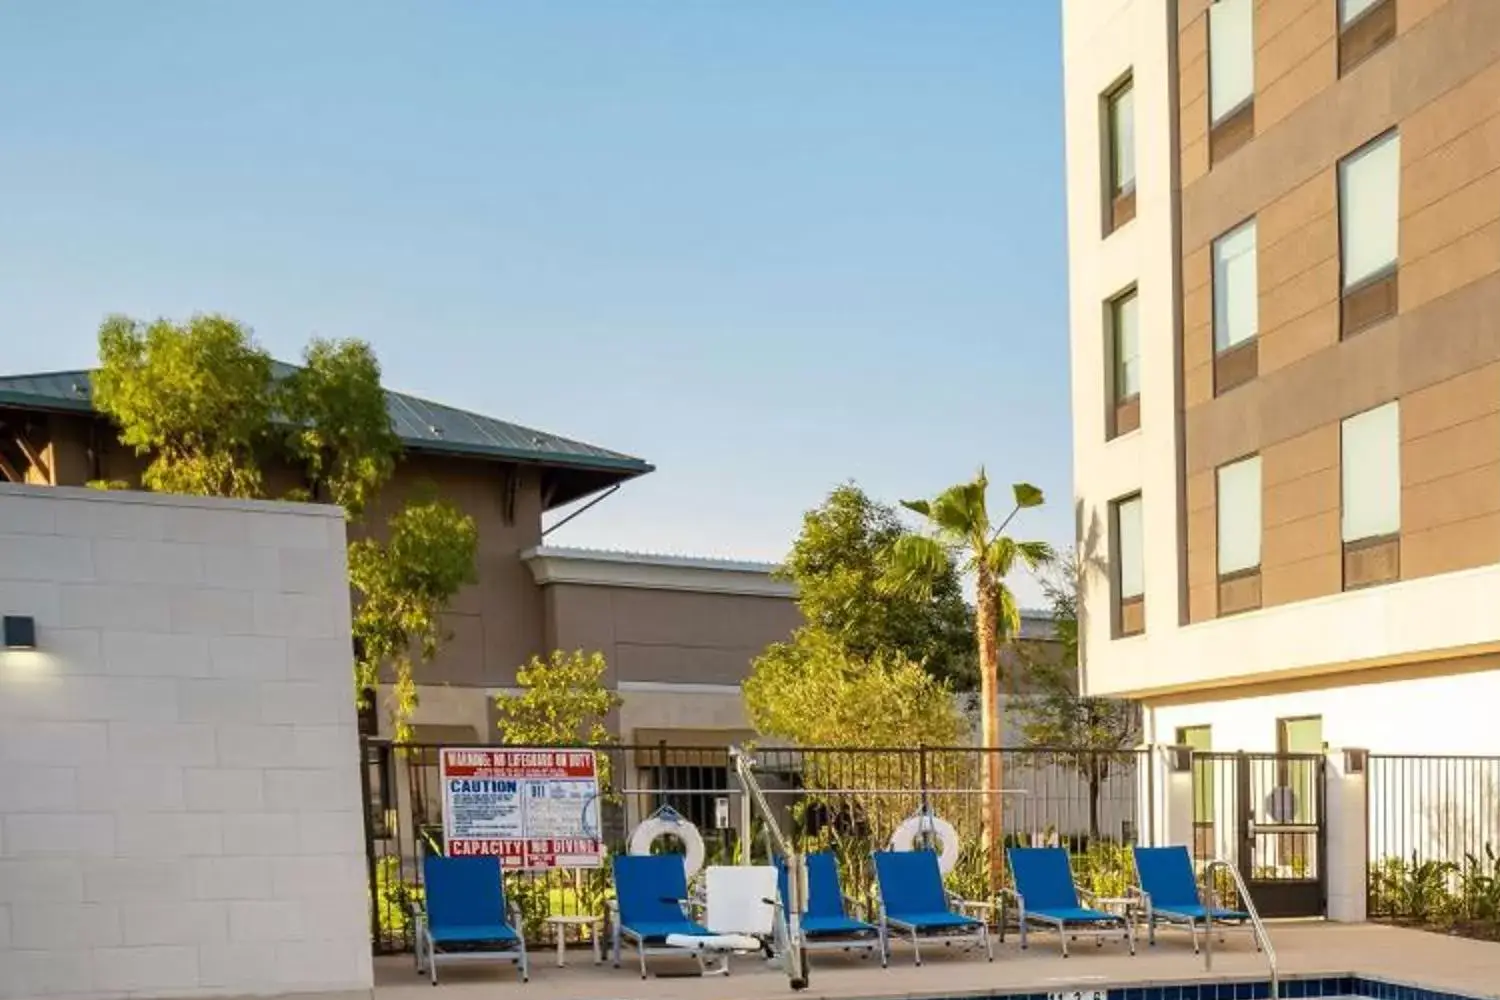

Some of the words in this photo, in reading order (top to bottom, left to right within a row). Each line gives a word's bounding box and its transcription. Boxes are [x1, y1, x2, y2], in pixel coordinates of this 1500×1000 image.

[493, 753, 506, 767] NO
[508, 753, 553, 767] LIFEGUARD
[555, 753, 566, 767] ON
[569, 753, 591, 767] DUTY
[451, 780, 516, 793] CAUTION
[453, 841, 521, 855] CAPACITY
[554, 840, 595, 853] DIVING
